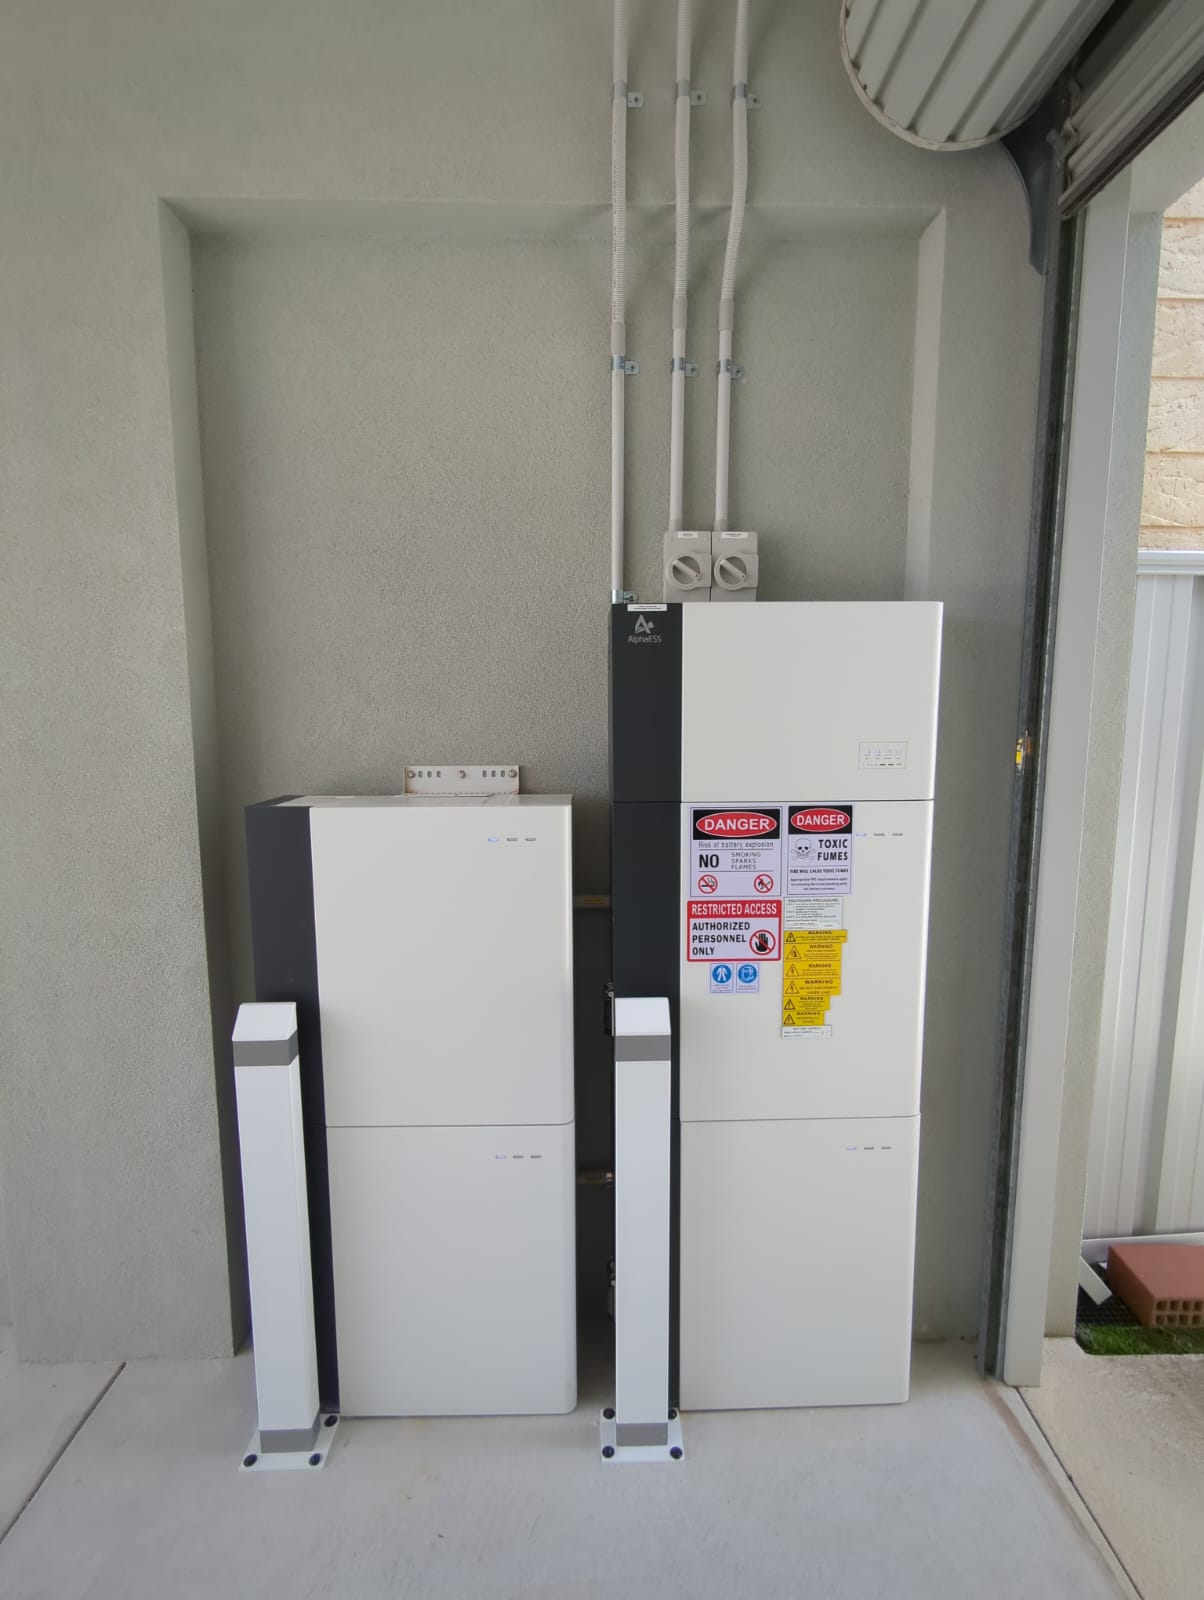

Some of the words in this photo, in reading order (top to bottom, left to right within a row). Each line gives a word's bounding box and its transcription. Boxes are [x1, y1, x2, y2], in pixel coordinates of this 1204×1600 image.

[628, 635, 662, 645] AlphaESS
[704, 818, 770, 831] DANGER
[796, 814, 845, 826] DANGER
[721, 841, 742, 850] battery
[744, 842, 774, 850] explosion
[818, 839, 848, 849] TOXIC
[698, 854, 720, 868] NO
[817, 851, 848, 861] FUMES
[692, 904, 742, 915] RESTRICTED
[744, 904, 777, 914] ACCESS
[692, 922, 750, 931] AUTHORIZED
[692, 934, 746, 944] PERSONNEL
[692, 946, 715, 956] ONLY
